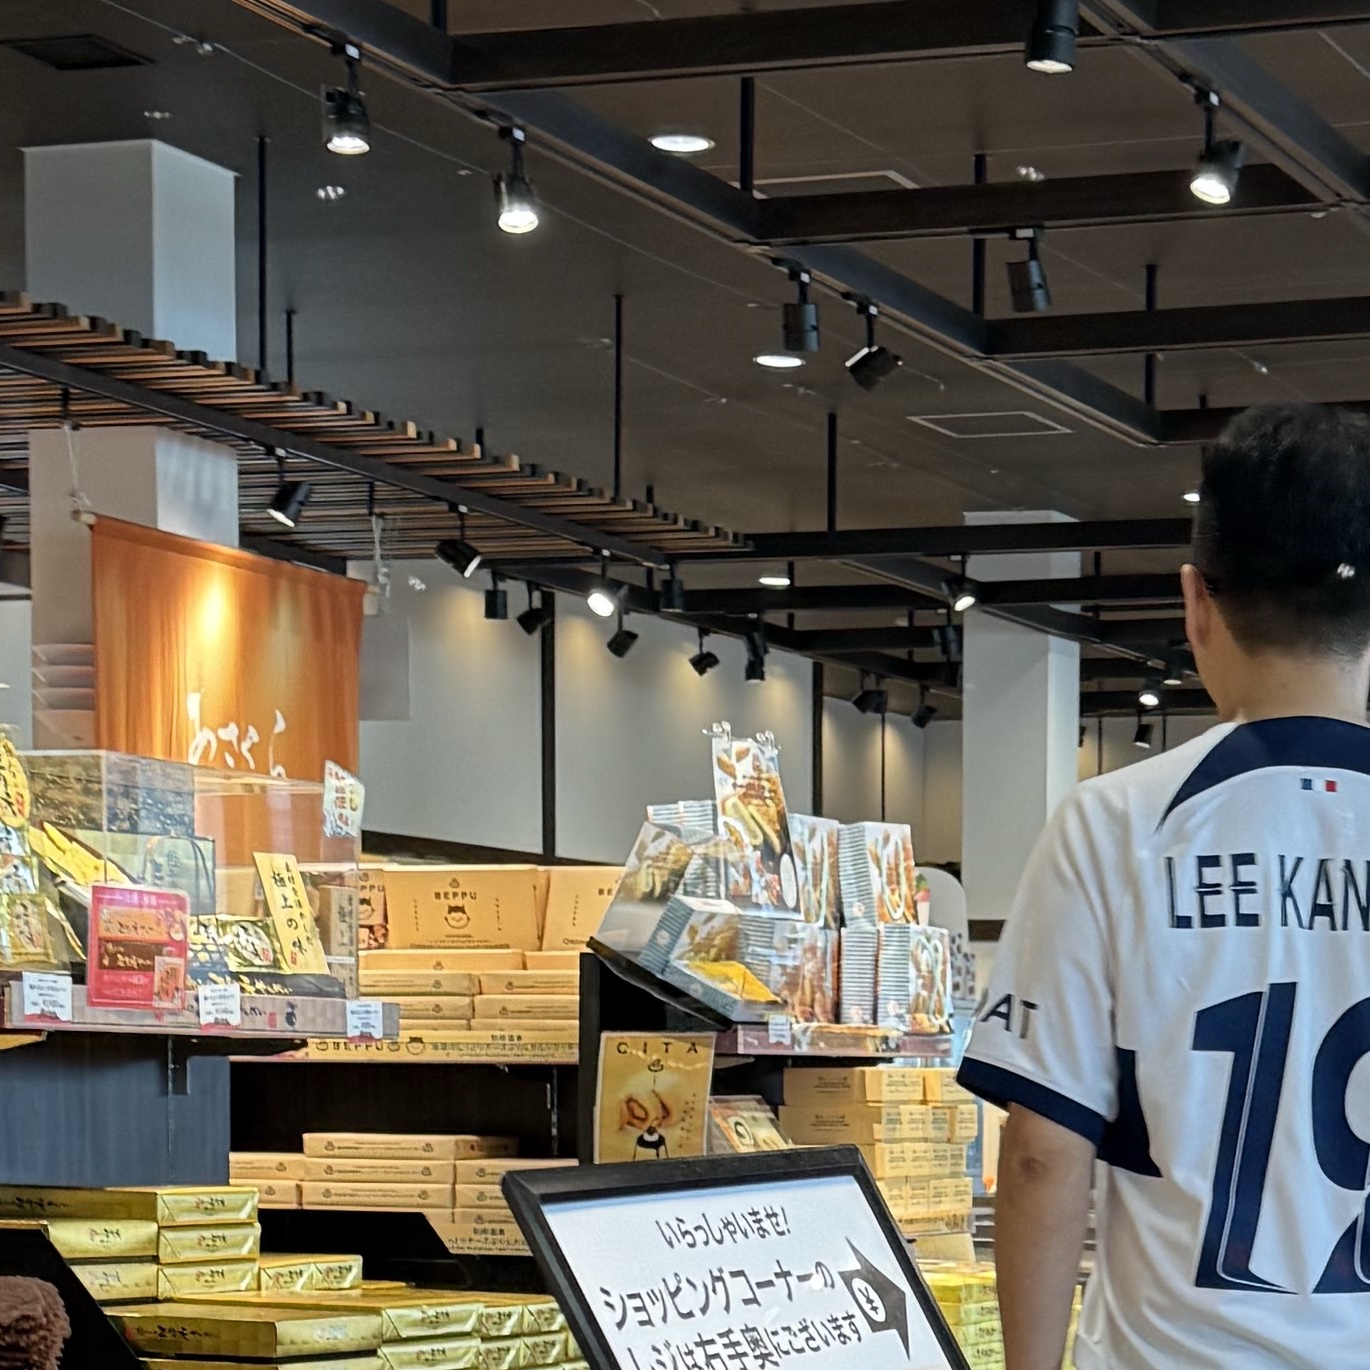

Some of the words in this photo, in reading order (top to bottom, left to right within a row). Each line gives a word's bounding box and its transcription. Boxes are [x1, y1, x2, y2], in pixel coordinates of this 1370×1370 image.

[434, 891, 477, 901] BEPPU
[1164, 852, 1261, 929] LEE
[655, 1205, 792, 1250] いらっしゃいませ!
[599, 1259, 836, 1332] ショッピングコーナーの
